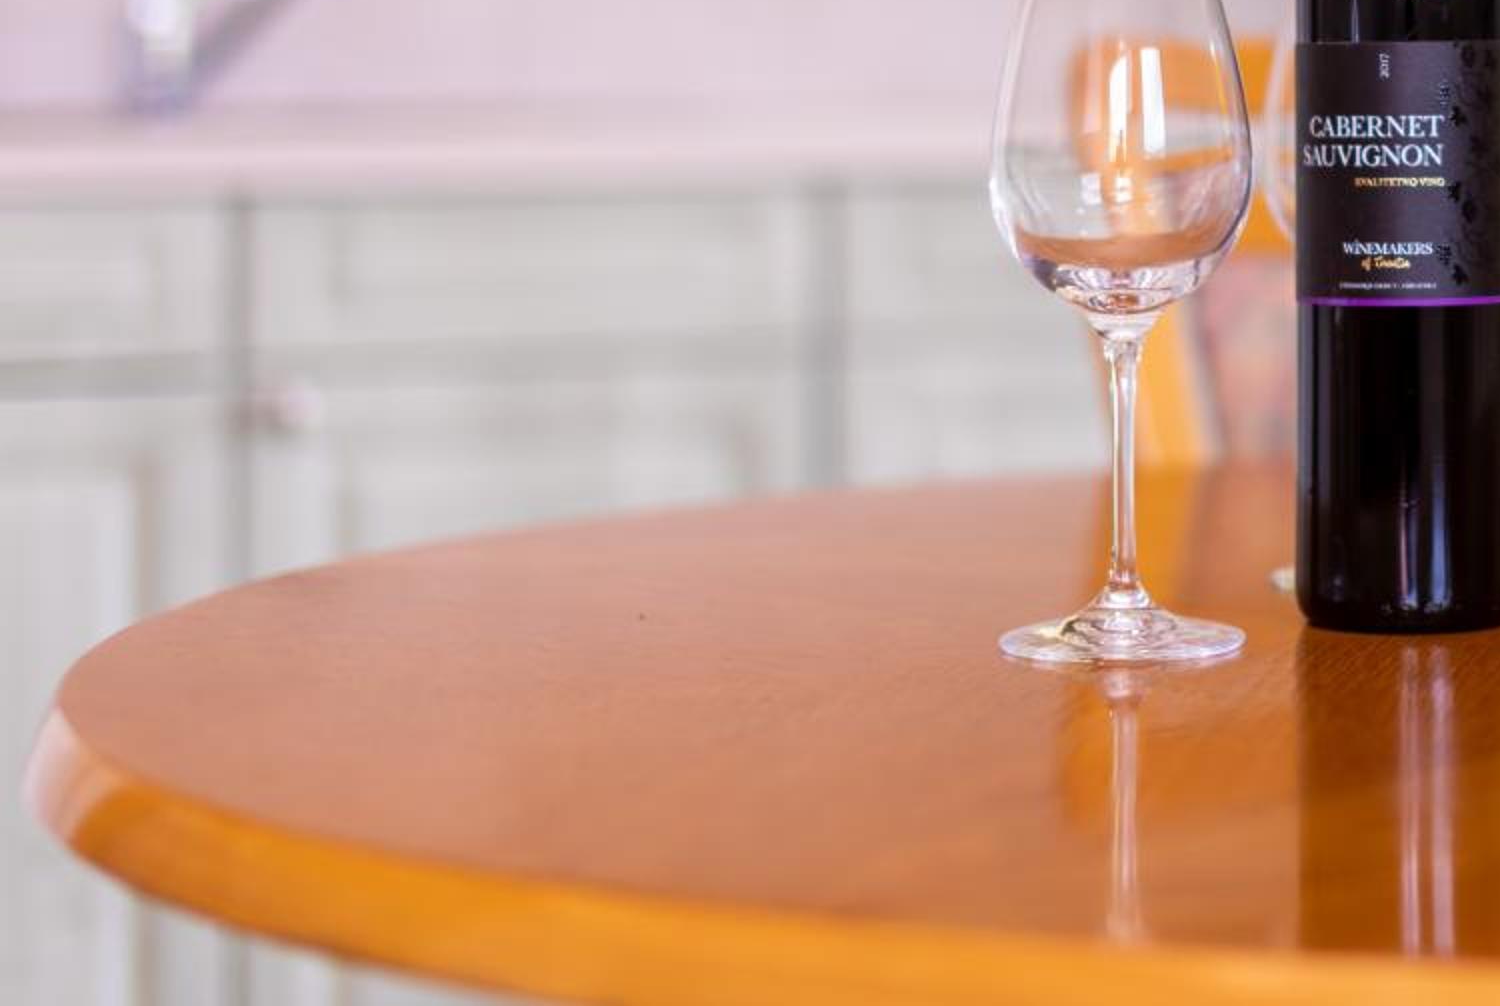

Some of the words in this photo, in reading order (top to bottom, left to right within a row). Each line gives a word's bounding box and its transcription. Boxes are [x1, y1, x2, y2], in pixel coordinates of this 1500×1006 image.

[1379, 53, 1390, 79] 2017
[1309, 115, 1444, 138] CABERNET
[1303, 144, 1444, 167] SAUVIGNON
[1419, 177, 1445, 187] VINO
